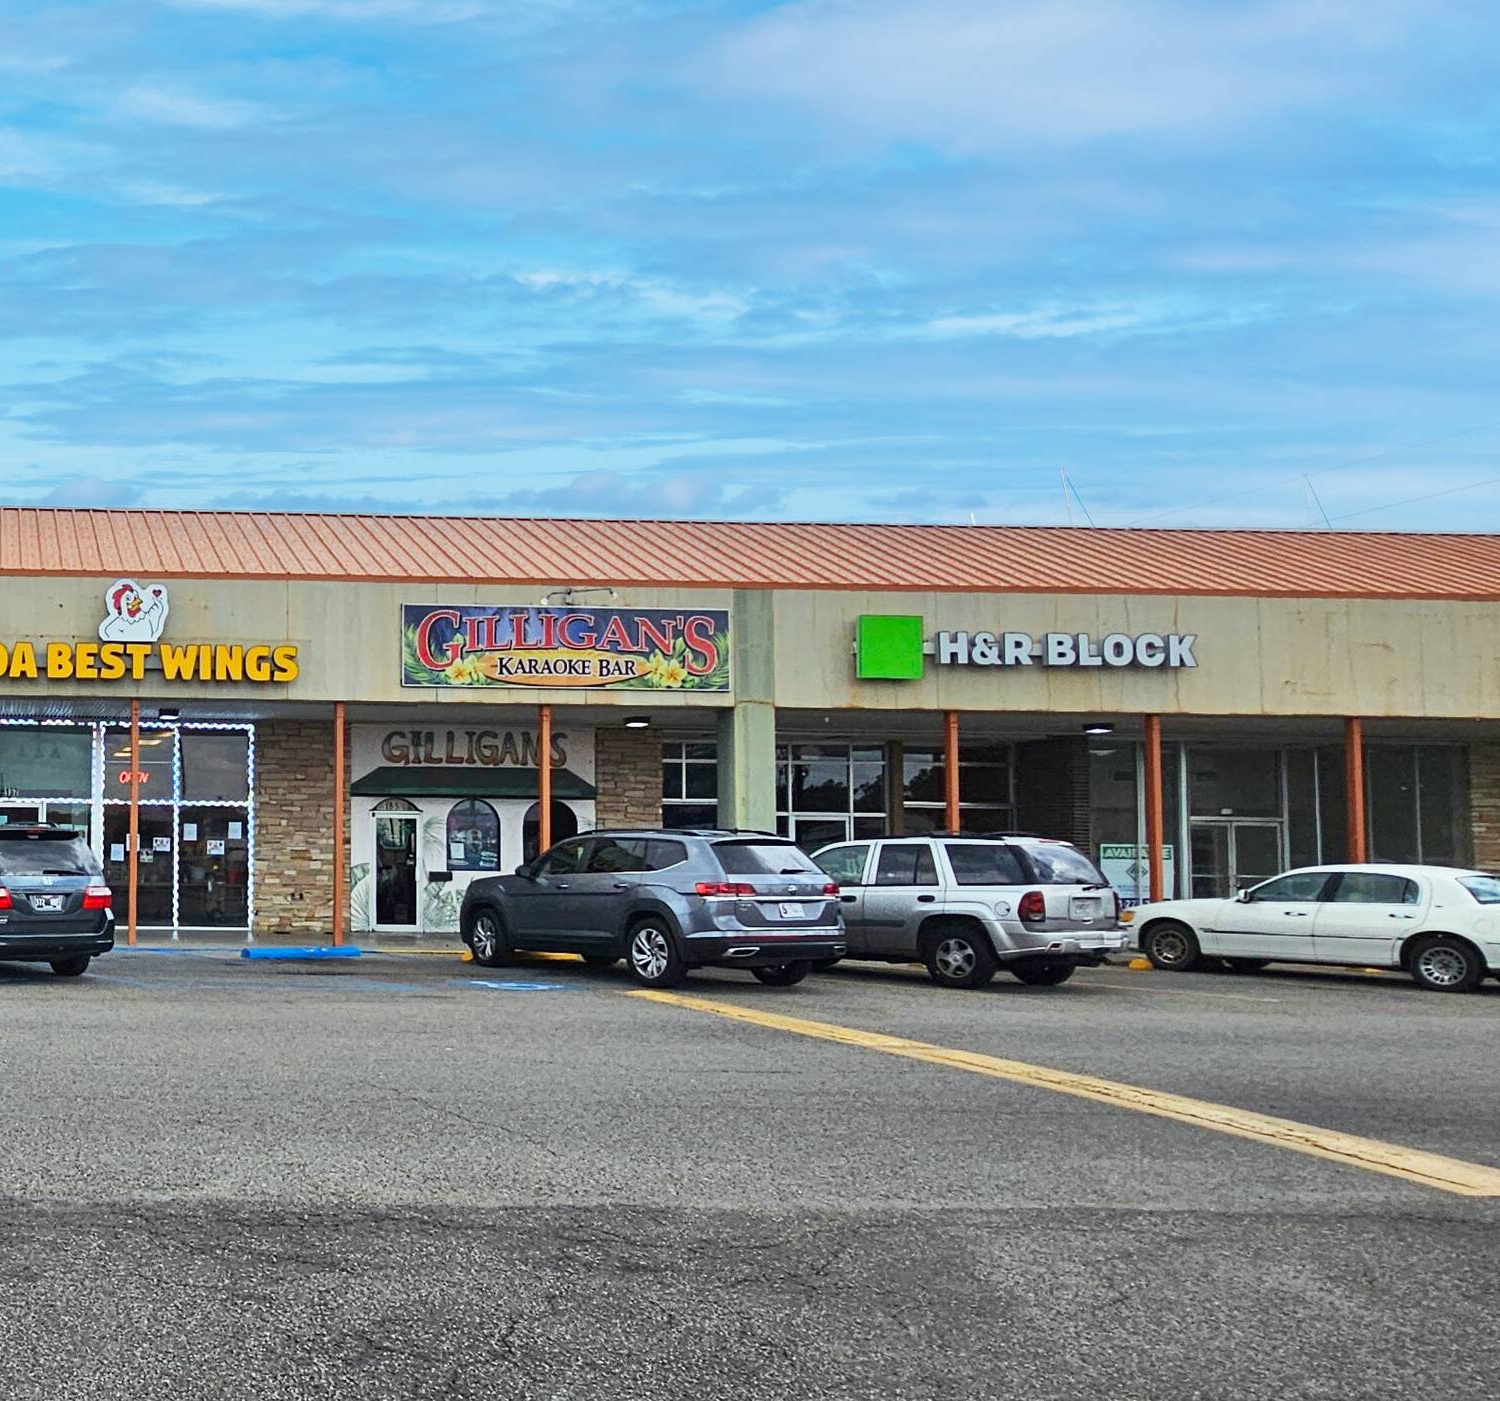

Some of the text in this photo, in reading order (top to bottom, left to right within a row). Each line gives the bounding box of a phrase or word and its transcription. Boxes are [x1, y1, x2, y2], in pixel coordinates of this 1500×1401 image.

[416, 609, 717, 676] GILLIGAN'S
[937, 631, 1197, 668] H&R BLOCK
[47, 643, 150, 680] BEST
[160, 644, 298, 682] WINGS
[499, 656, 636, 678] KARAOKE BAR
[119, 771, 149, 784] OPN
[1104, 848, 1171, 859] AVAIAE
